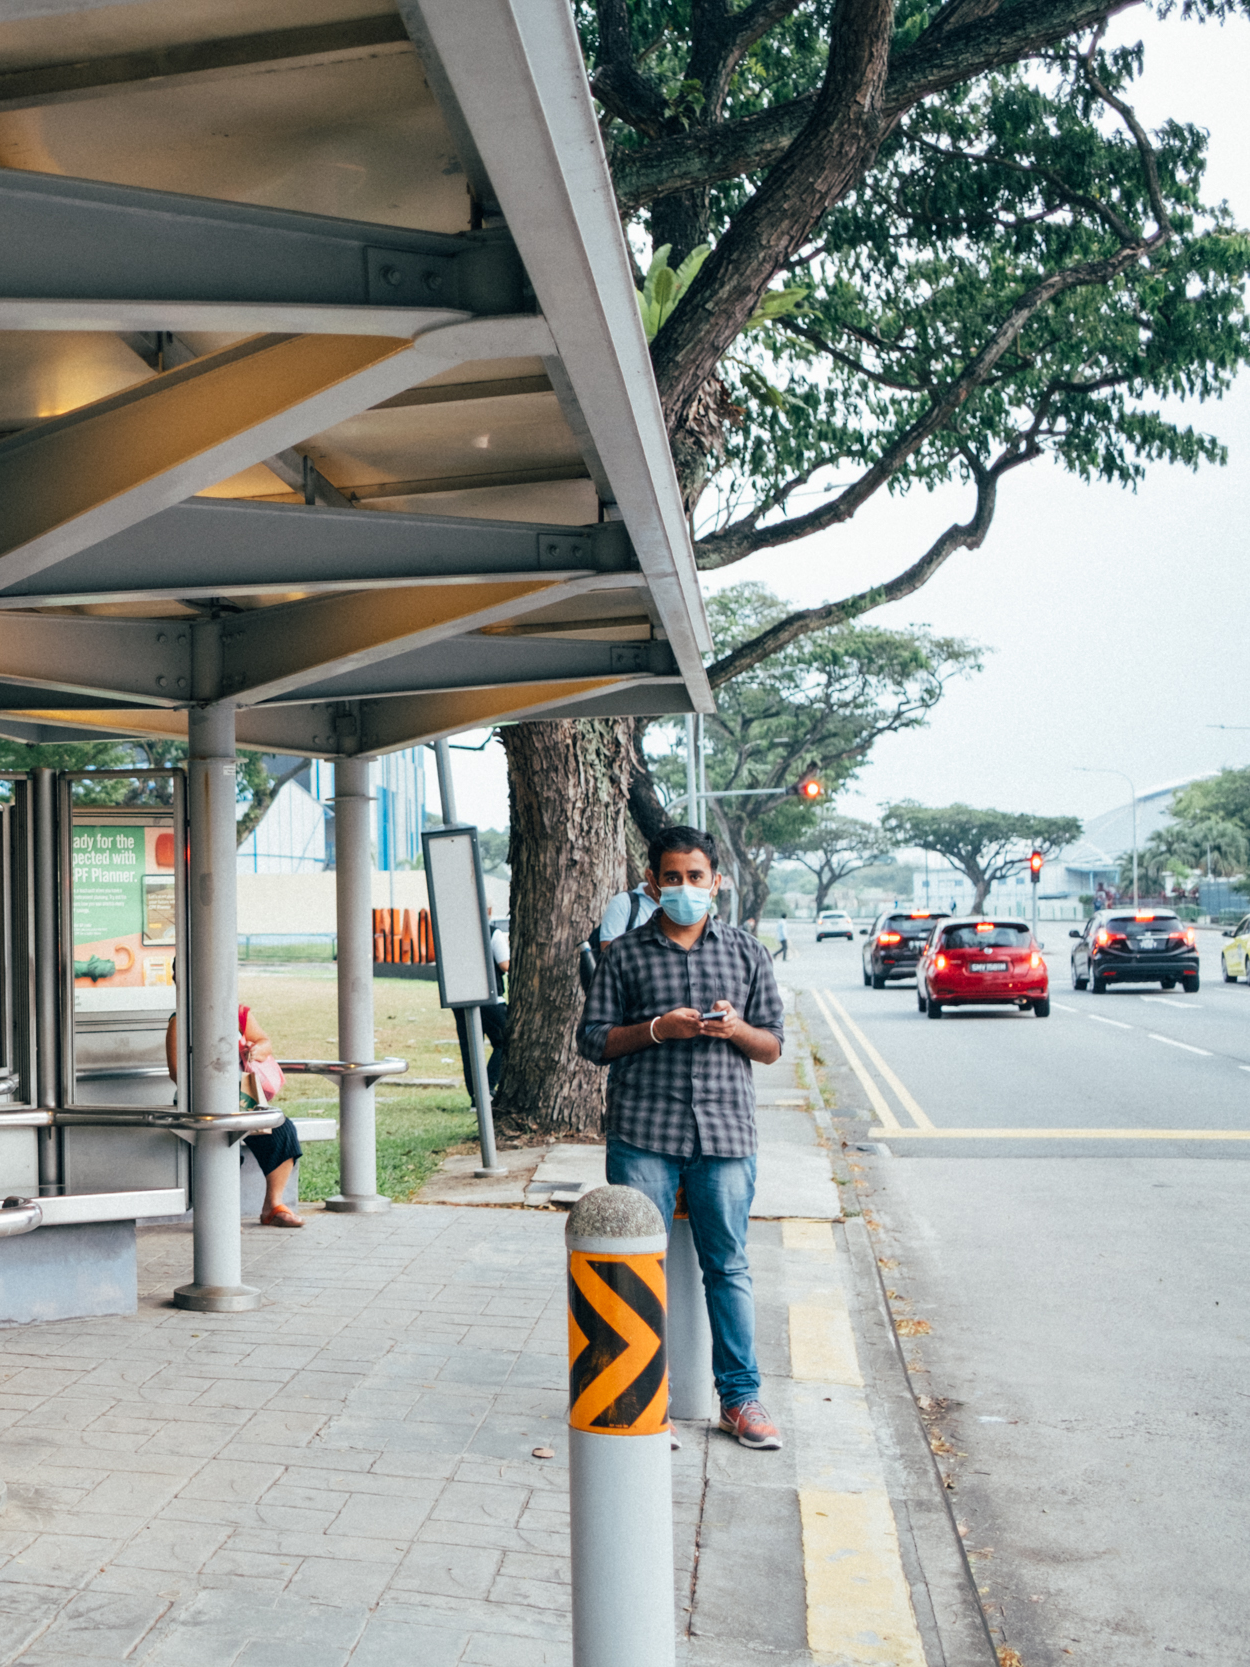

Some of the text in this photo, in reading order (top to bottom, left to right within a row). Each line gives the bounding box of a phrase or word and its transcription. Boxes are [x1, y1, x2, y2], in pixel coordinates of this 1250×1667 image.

[97, 833, 113, 848] for
[116, 833, 134, 848] the
[112, 850, 136, 865] with
[92, 868, 137, 883] Planner.
